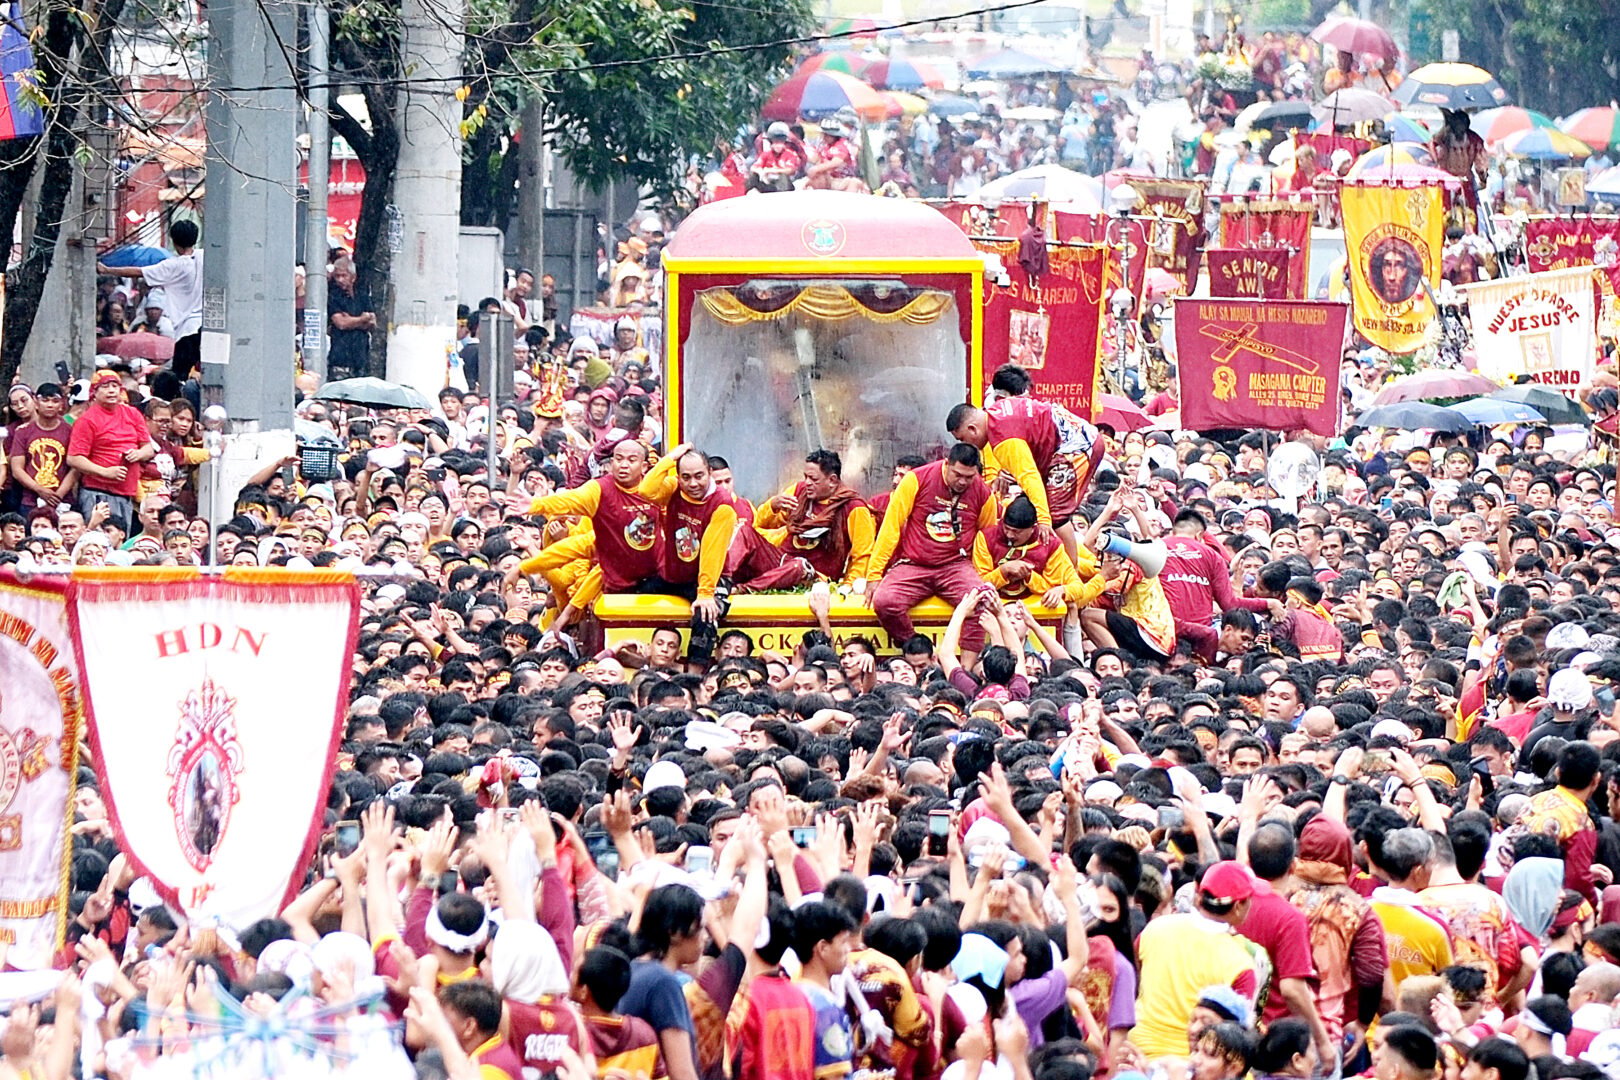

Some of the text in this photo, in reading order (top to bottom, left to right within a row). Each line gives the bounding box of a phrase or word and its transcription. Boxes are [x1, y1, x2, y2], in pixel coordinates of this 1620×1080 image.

[1199, 304, 1217, 320] ALAY
[1219, 306, 1229, 321] SA
[1541, 289, 1580, 324] PADRE
[1508, 311, 1561, 333] JESUS
[1249, 372, 1326, 394] MASAGANA CHAPTER
[1532, 370, 1580, 385] ARENO
[1035, 383, 1083, 395] CHAPTER
[153, 621, 270, 658] HDN
